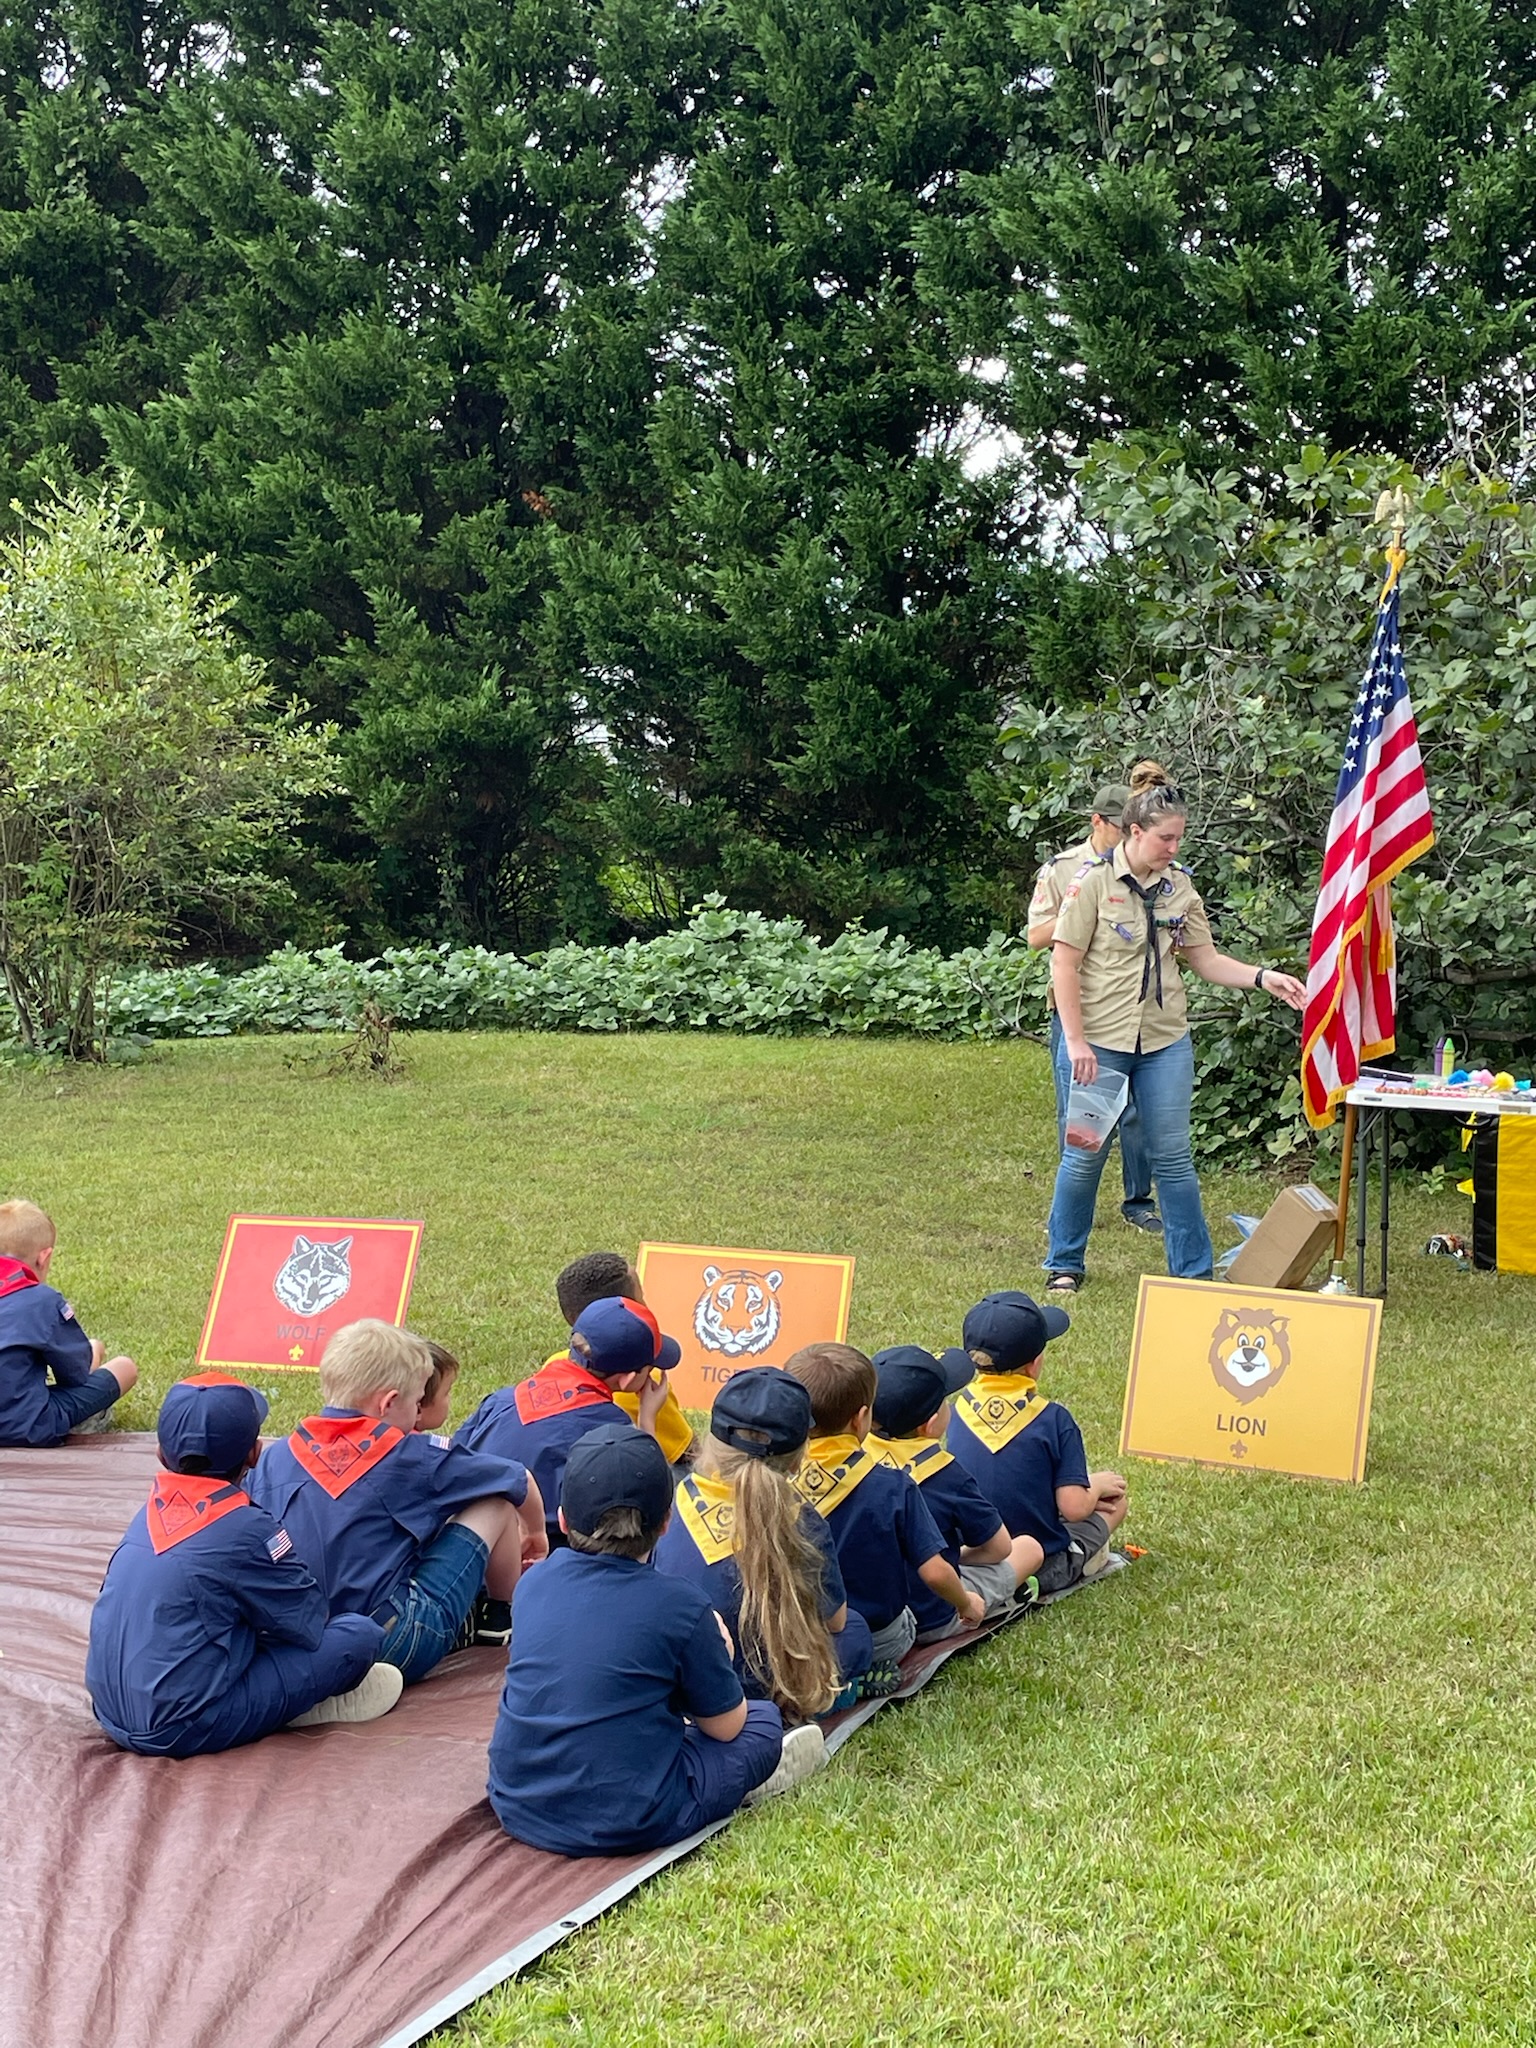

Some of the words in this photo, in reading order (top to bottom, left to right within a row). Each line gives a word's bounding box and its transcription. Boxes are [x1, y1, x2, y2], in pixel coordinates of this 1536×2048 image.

[276, 1325, 326, 1341] WOLF
[701, 1366, 741, 1383] TIG
[1216, 1413, 1267, 1436] LION
